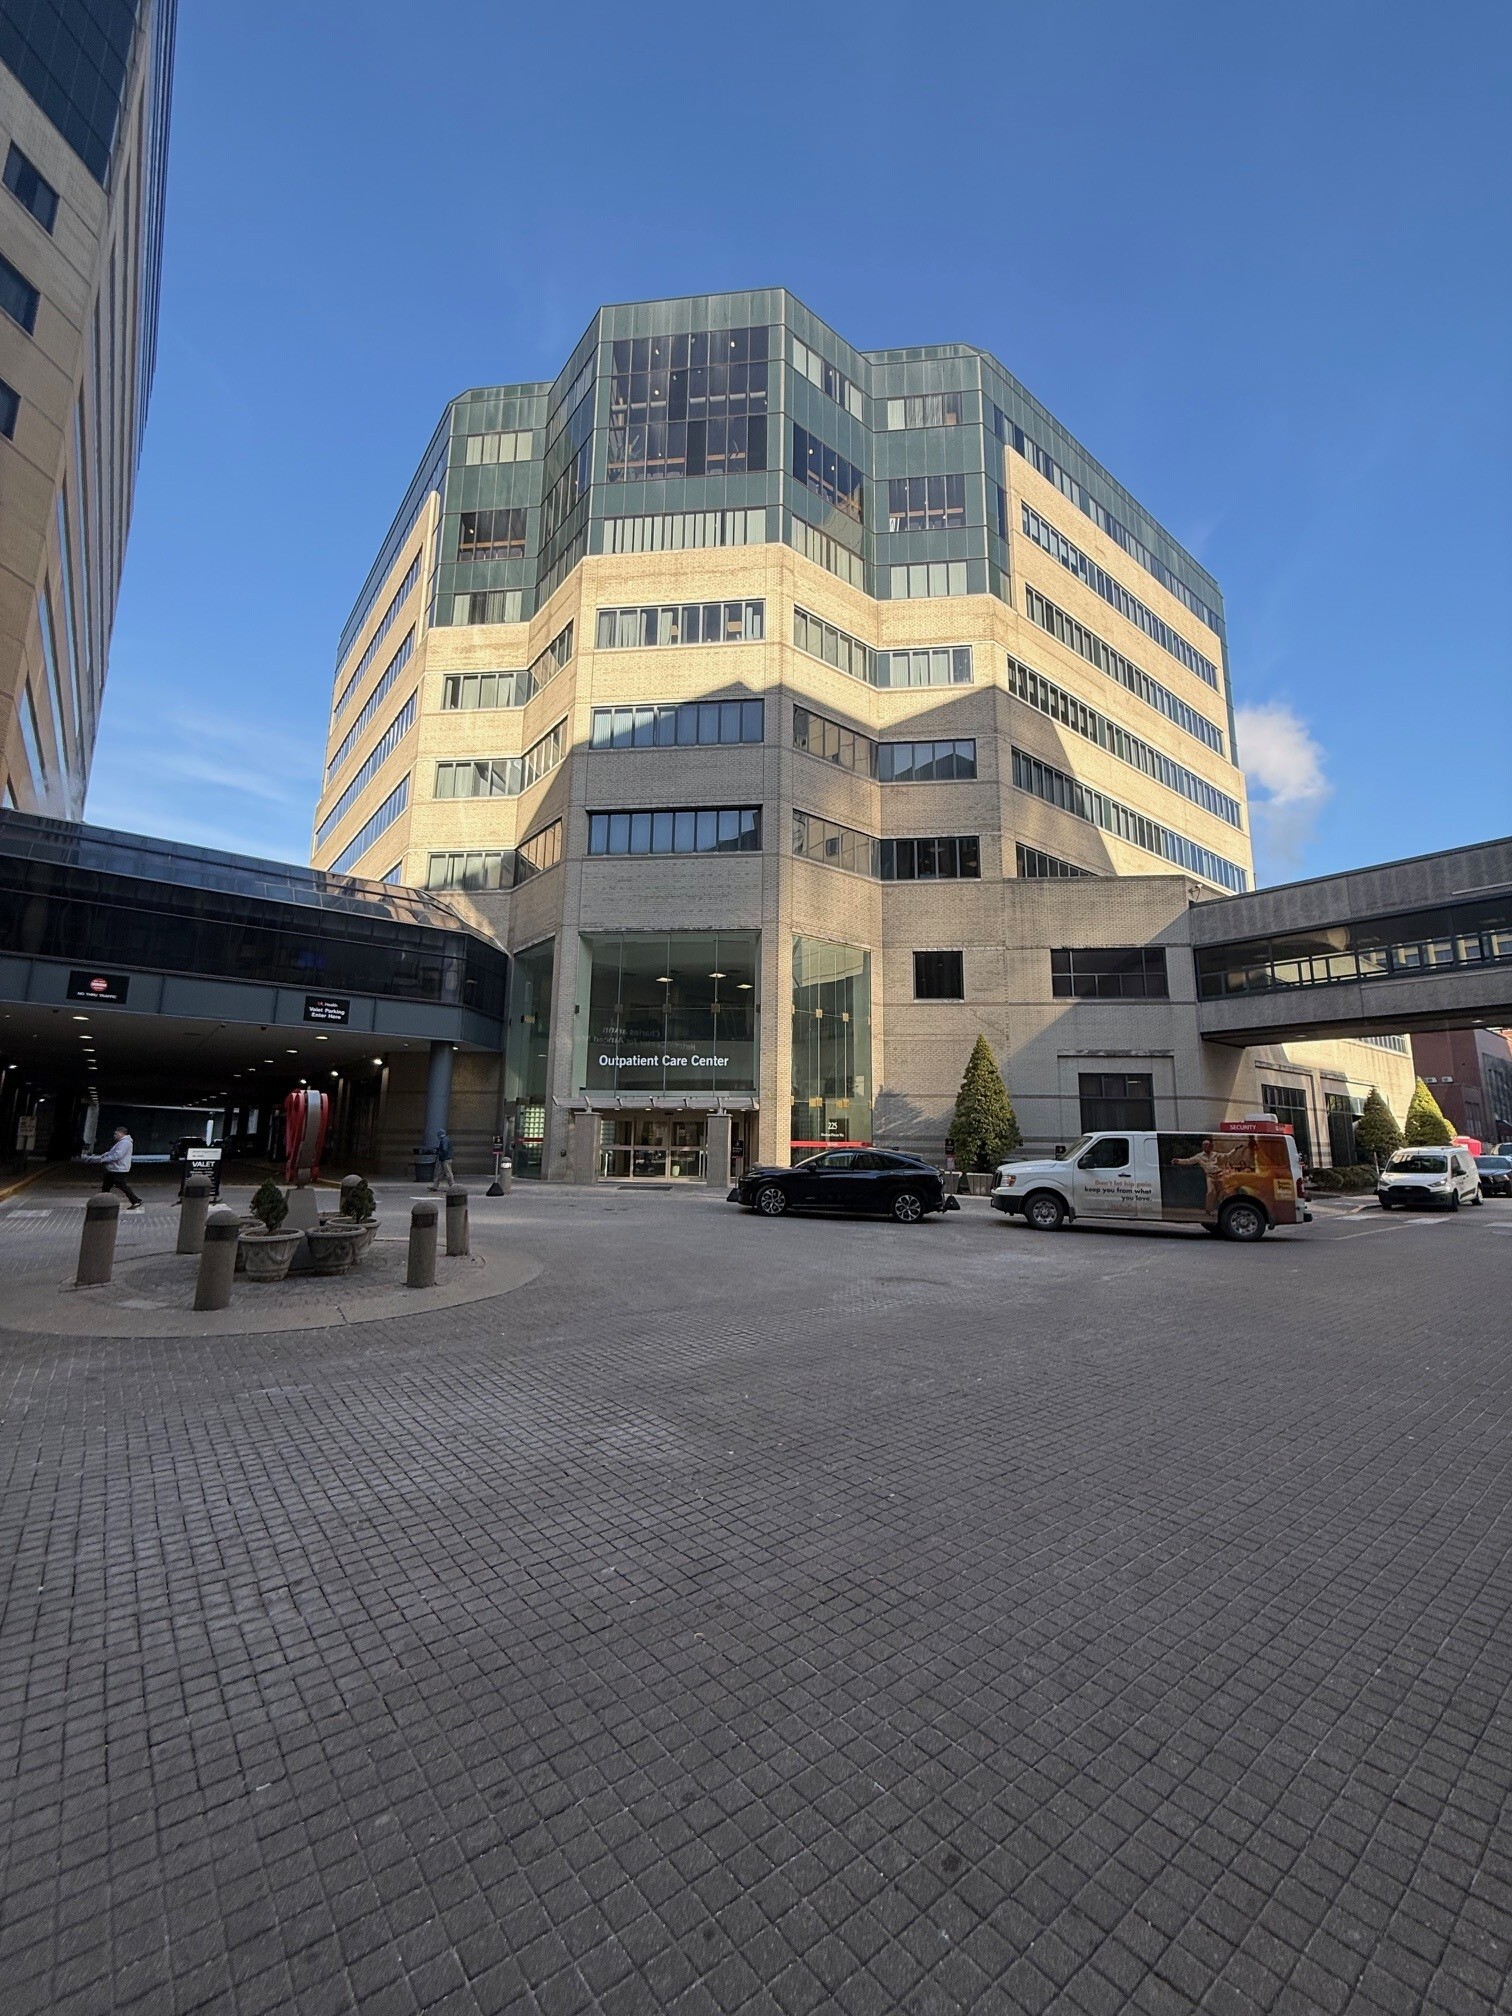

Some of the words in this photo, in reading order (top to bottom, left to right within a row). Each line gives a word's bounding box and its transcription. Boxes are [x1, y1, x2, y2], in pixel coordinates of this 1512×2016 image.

[324, 1008, 345, 1016] Parking
[599, 1055, 658, 1068] Outpatient
[662, 1055, 687, 1066] Care
[691, 1055, 729, 1066] Center
[828, 1122, 838, 1130] 225
